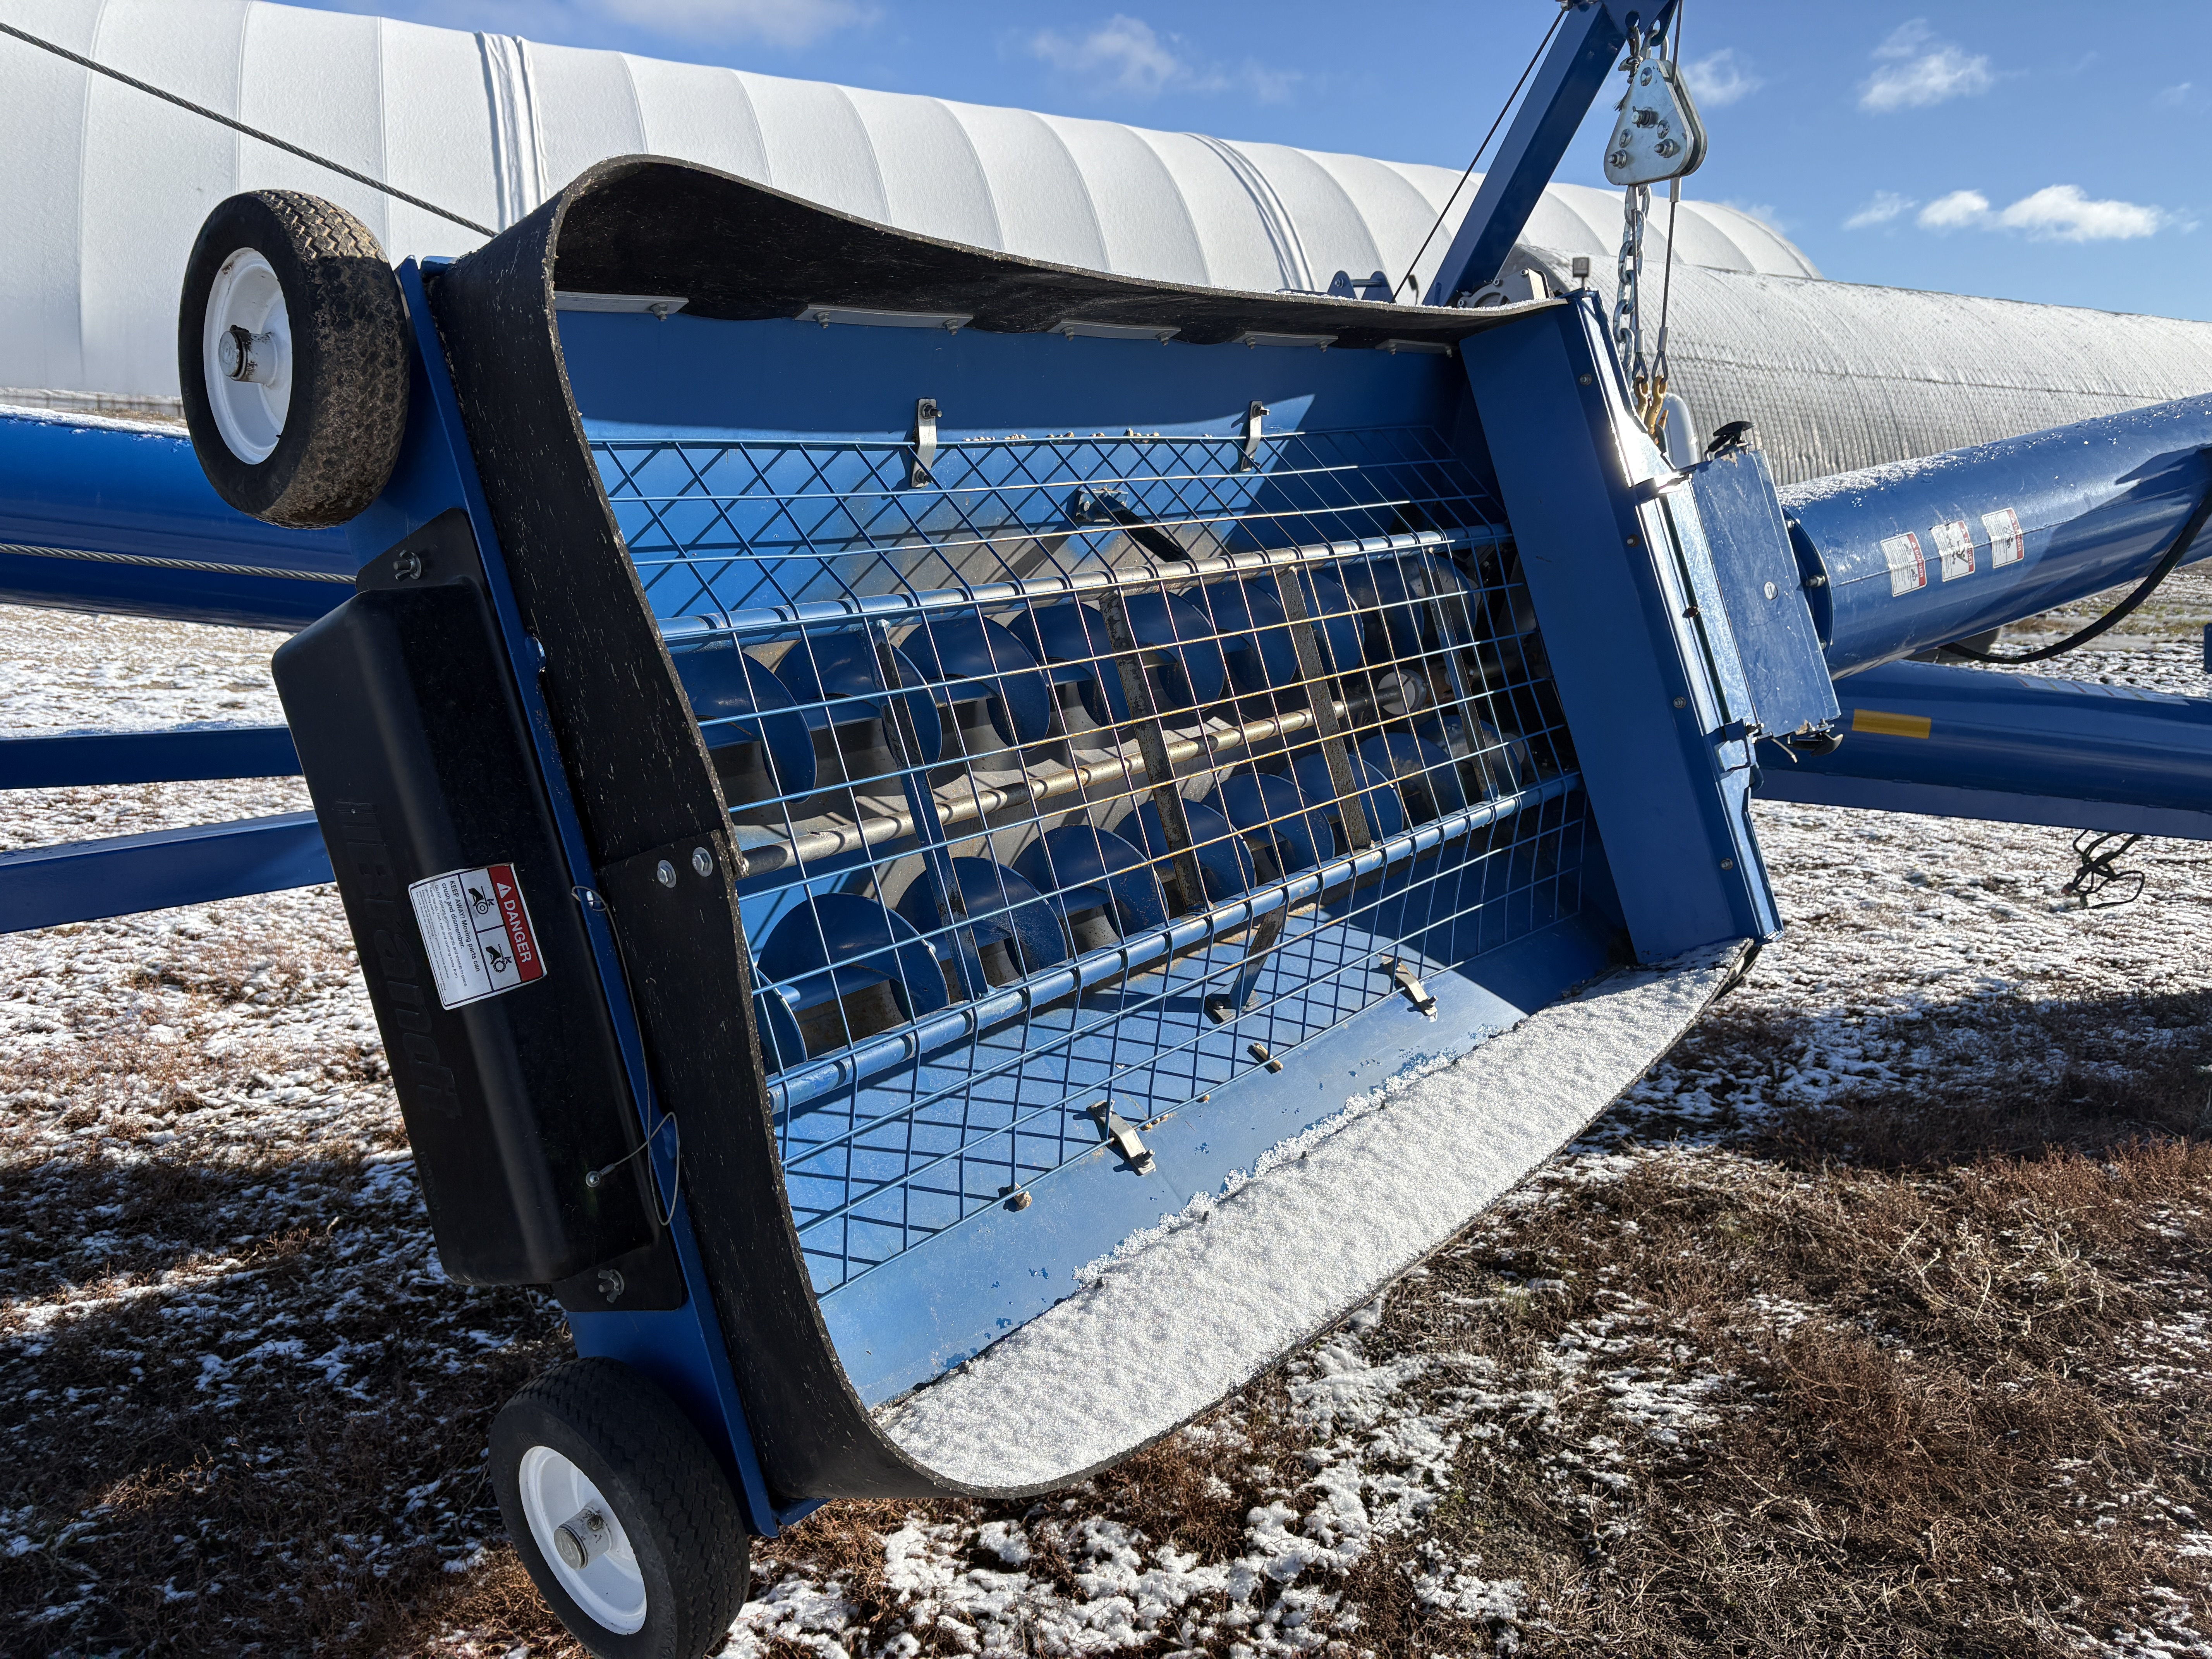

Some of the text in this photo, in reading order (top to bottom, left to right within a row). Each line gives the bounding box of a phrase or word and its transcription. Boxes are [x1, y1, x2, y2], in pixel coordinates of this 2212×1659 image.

[1915, 549, 1923, 578] DANGER
[441, 883, 464, 949] crush and dismember.
[450, 880, 459, 897] KEEP
[455, 899, 465, 919] AWAY!
[461, 920, 471, 943] Moving
[467, 943, 476, 959] parts
[504, 900, 532, 963] DANGER
[347, 843, 462, 1120] Brandt
